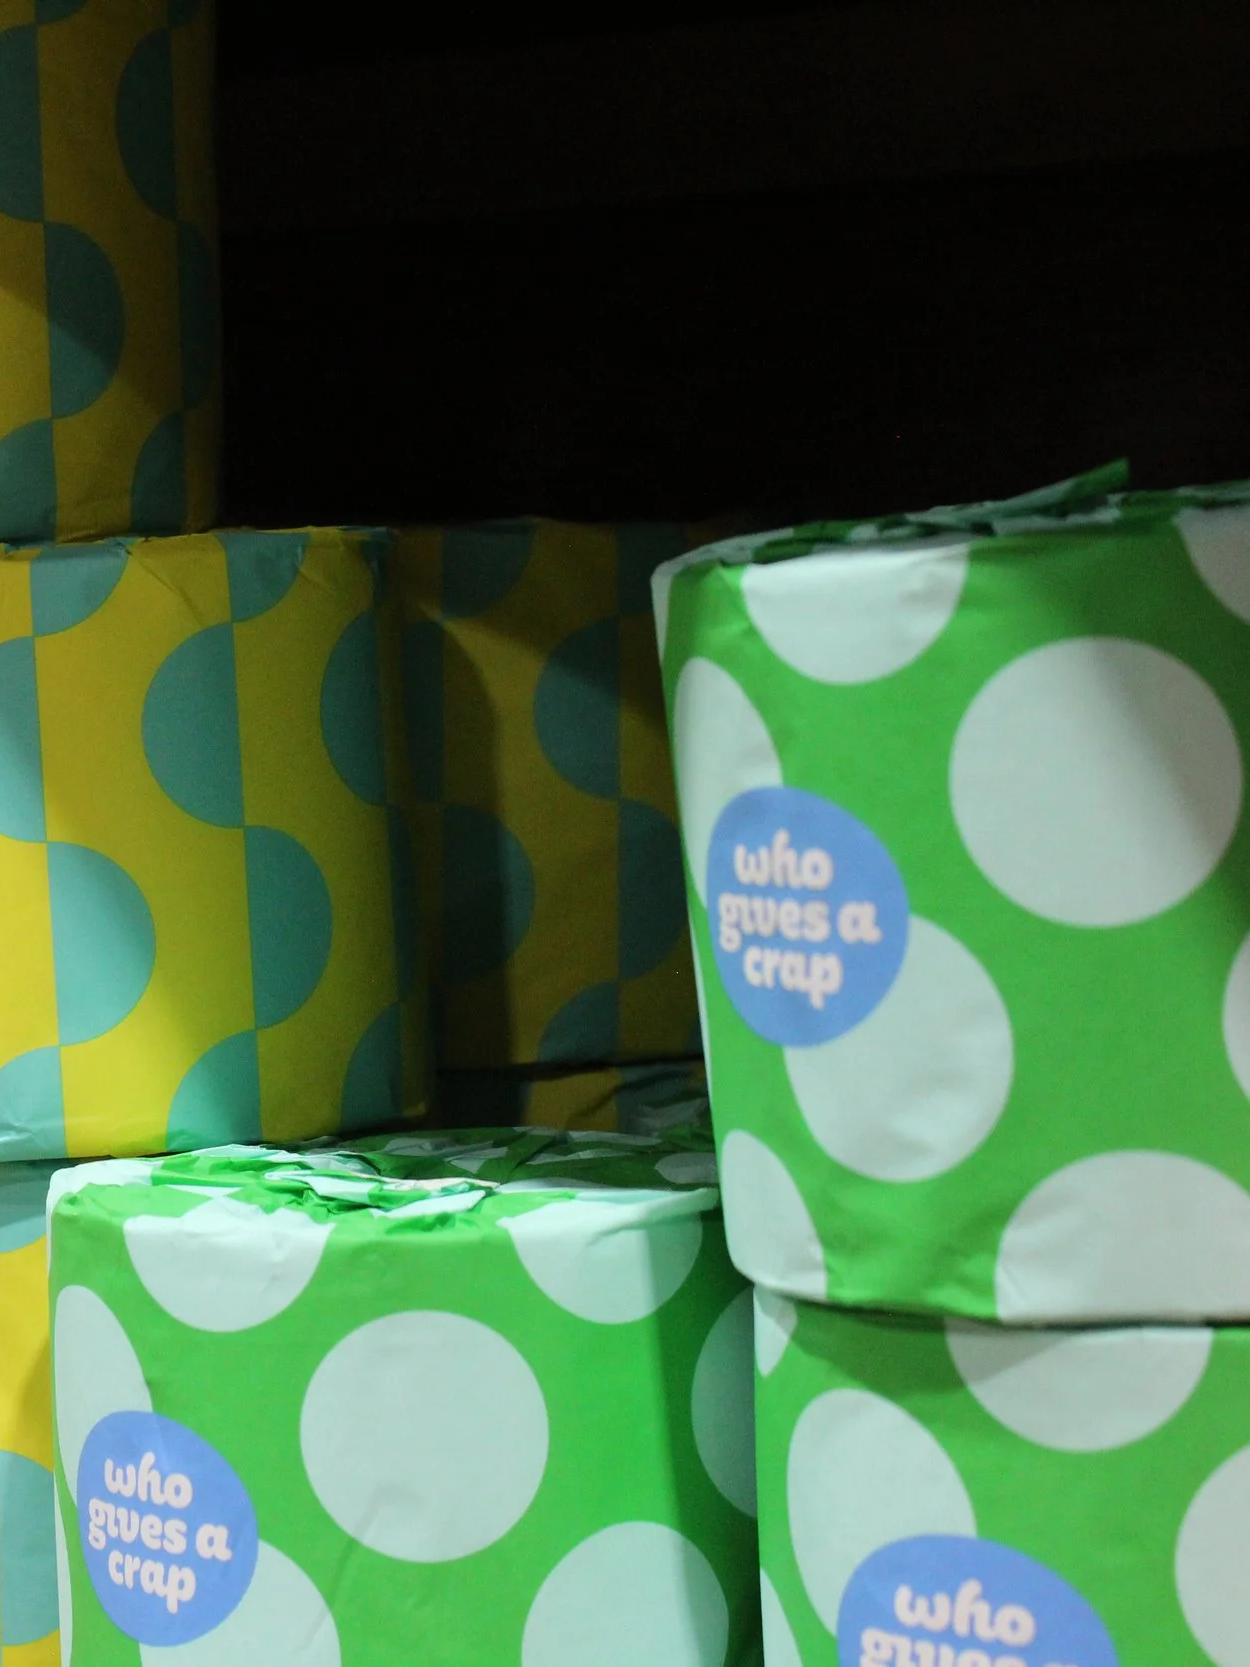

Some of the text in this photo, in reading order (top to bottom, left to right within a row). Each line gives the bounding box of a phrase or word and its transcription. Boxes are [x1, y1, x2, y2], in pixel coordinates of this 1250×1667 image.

[734, 828, 834, 891] who
[718, 893, 883, 952] gives a
[743, 945, 844, 1010] crap
[104, 1451, 193, 1509] who
[88, 1498, 232, 1561] gives a
[108, 1549, 196, 1614] crap
[894, 1577, 1036, 1647] who
